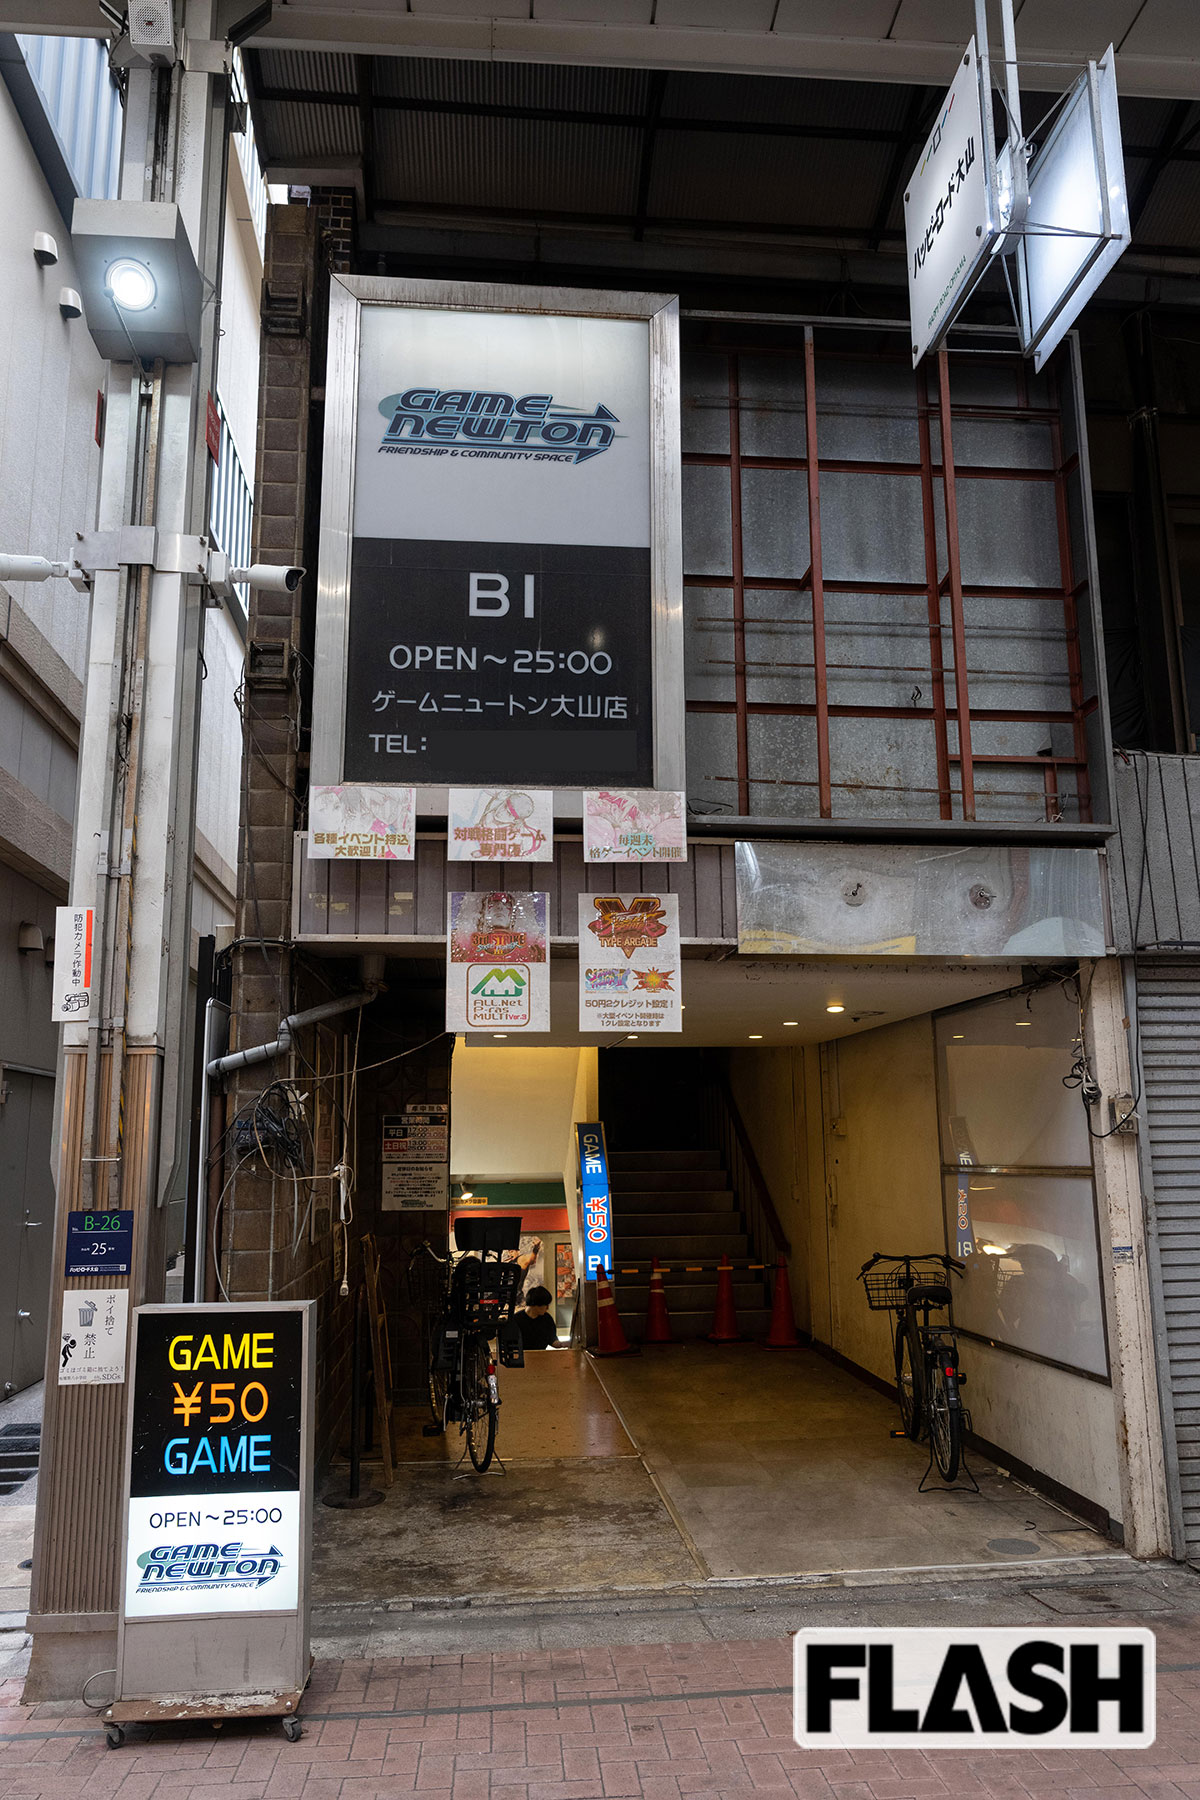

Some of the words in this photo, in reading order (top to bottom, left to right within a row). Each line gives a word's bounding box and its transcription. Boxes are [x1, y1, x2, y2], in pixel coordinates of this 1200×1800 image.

[913, 136, 976, 280] ハッピーロード大山
[399, 387, 553, 418] GAME
[386, 412, 616, 447] NEWTON
[378, 446, 448, 457] FRIENDSHIP
[460, 449, 533, 461] COMMUNITY
[533, 453, 574, 463] SPACE
[372, 690, 628, 720] ゲームニュートン大山店
[369, 733, 428, 754] TEL:
[314, 833, 409, 846] 各種イベント持込
[454, 827, 547, 842] 対戦格闘ゲーム
[618, 833, 654, 846] 毎週末
[479, 843, 521, 857] 専門店
[589, 846, 683, 859] 格ゲーイベント開催
[71, 913, 83, 987] 防犯カメラ作動中
[472, 934, 490, 946] 3rd
[491, 934, 526, 946] STRIKE
[598, 937, 622, 948] TYPE
[623, 937, 658, 948] ARCADE
[474, 999, 523, 1007] ALL.Net
[388, 1128, 403, 1137] 平日
[583, 1133, 602, 1174] GAME
[84, 1215, 121, 1231] B-26
[585, 1195, 608, 1244] ¥50
[91, 1242, 107, 1255] 25
[105, 1294, 116, 1336] ポイ捨て
[83, 1333, 97, 1360] 禁止
[168, 1333, 274, 1371] GAME
[173, 1381, 269, 1427] ¥50
[164, 1435, 271, 1475] GAME
[150, 1542, 243, 1561] GAME
[141, 1558, 281, 1581] NEWTON
[136, 1585, 179, 1593] FRIENDSHIP
[186, 1583, 230, 1591] COMMUNITY
